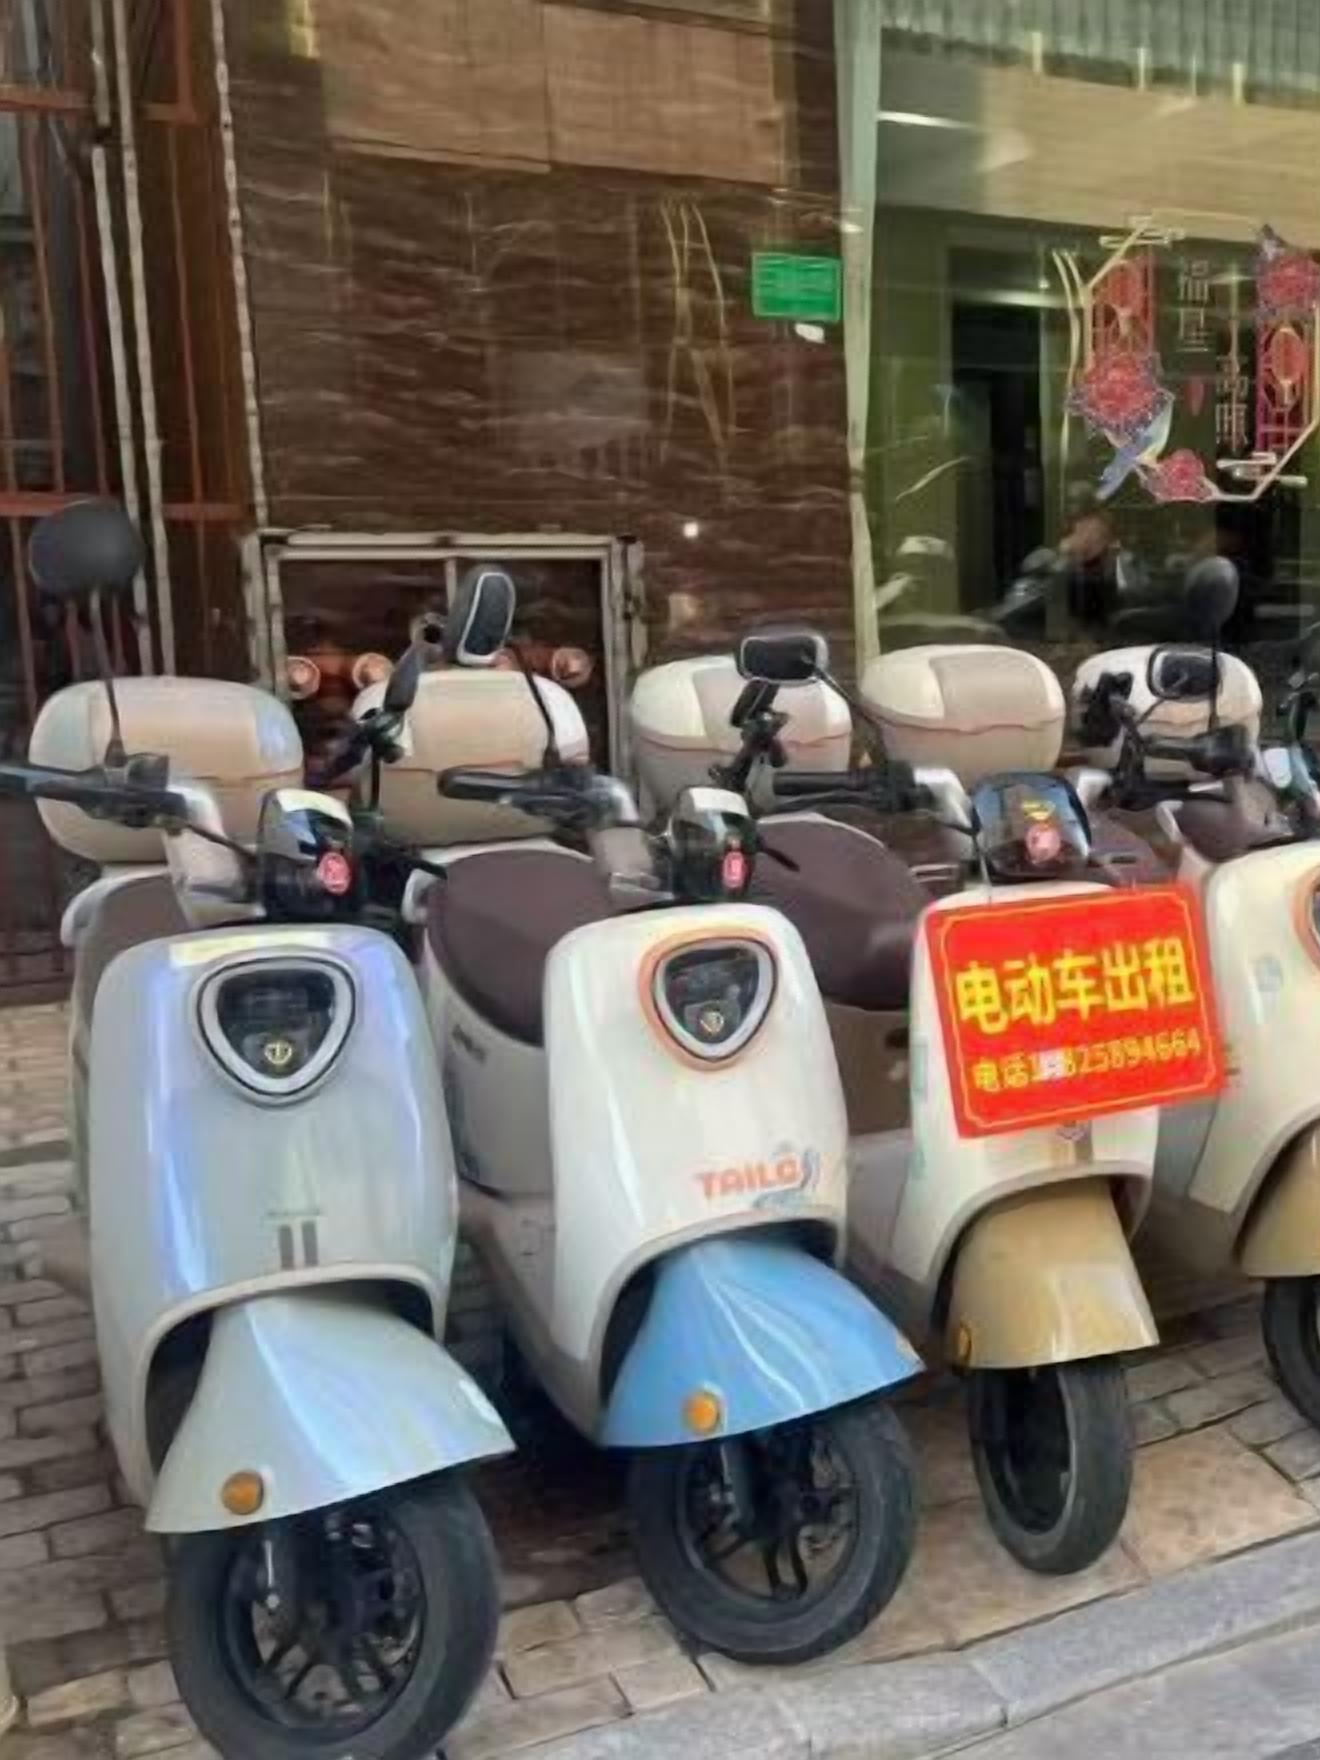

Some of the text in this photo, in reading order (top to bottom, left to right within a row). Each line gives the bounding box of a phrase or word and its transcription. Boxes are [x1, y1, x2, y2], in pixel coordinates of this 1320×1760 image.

[956, 937, 1196, 1035] 电动车出租
